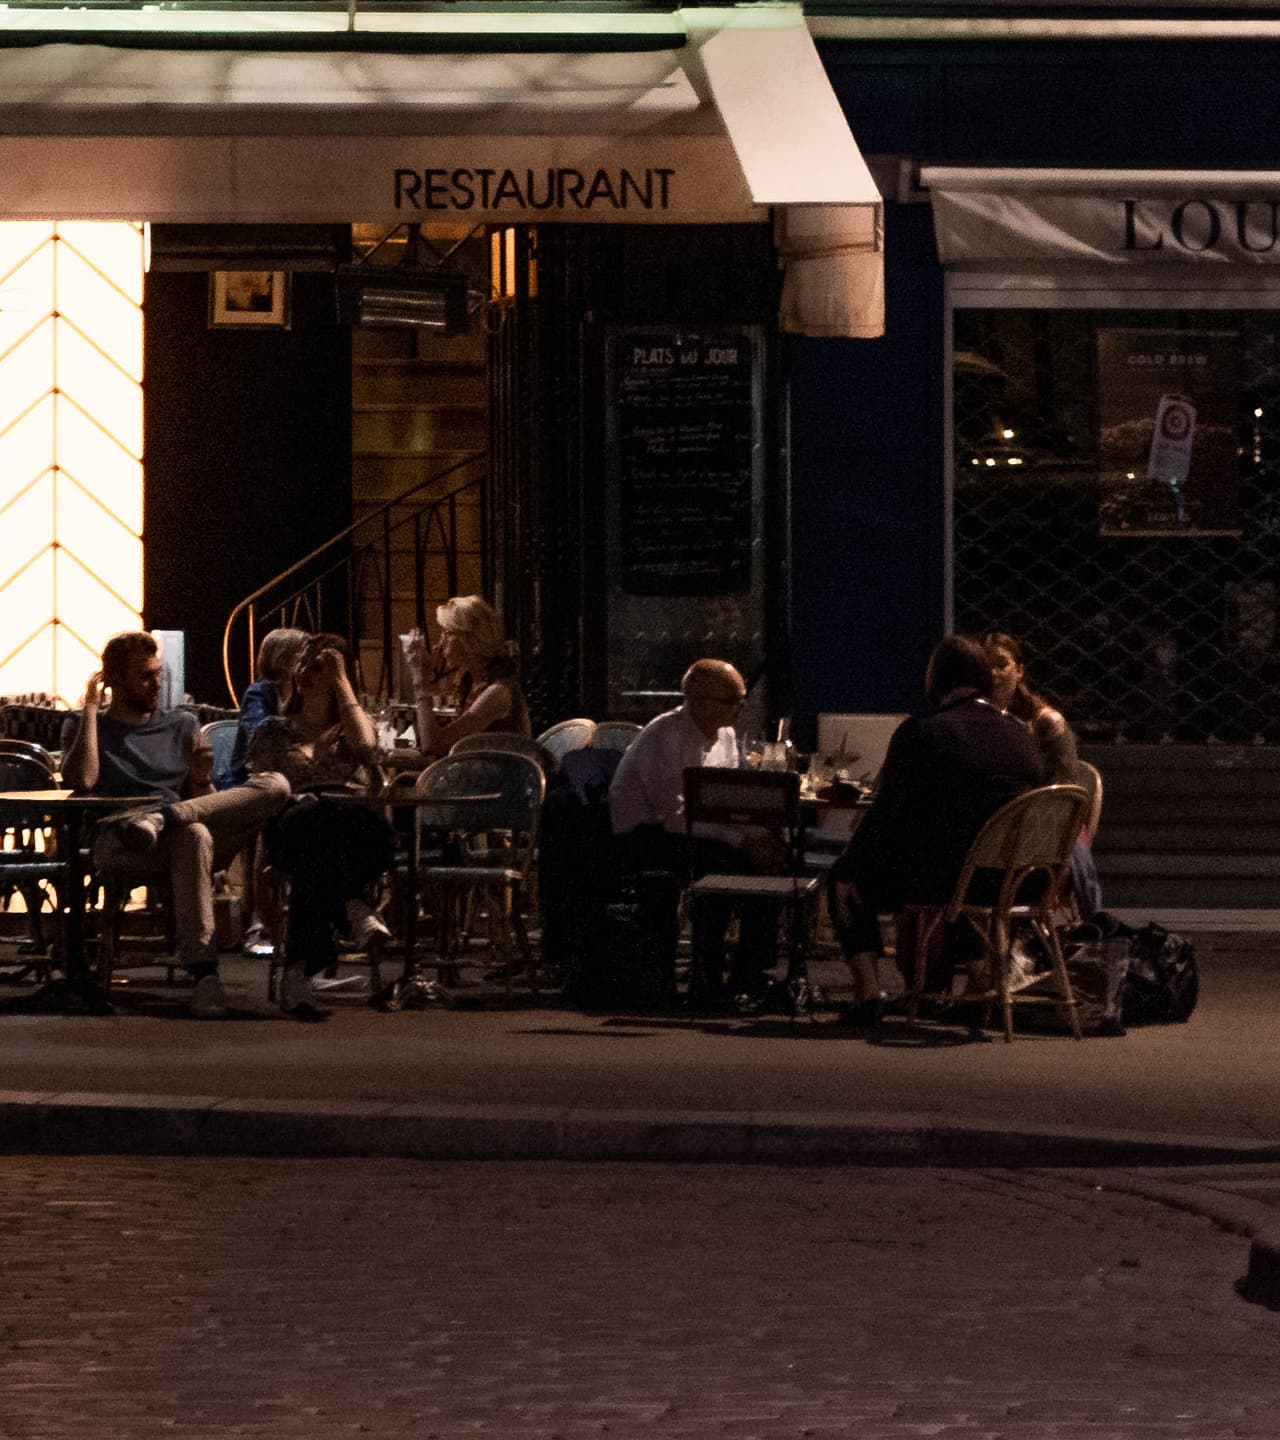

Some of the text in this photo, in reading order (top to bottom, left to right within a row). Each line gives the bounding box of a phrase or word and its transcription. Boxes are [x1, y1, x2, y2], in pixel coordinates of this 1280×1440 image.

[393, 167, 676, 210] RESTAURANT
[632, 347, 675, 365] PLATS
[704, 347, 739, 365] JOUR
[1127, 353, 1166, 366] COLD
